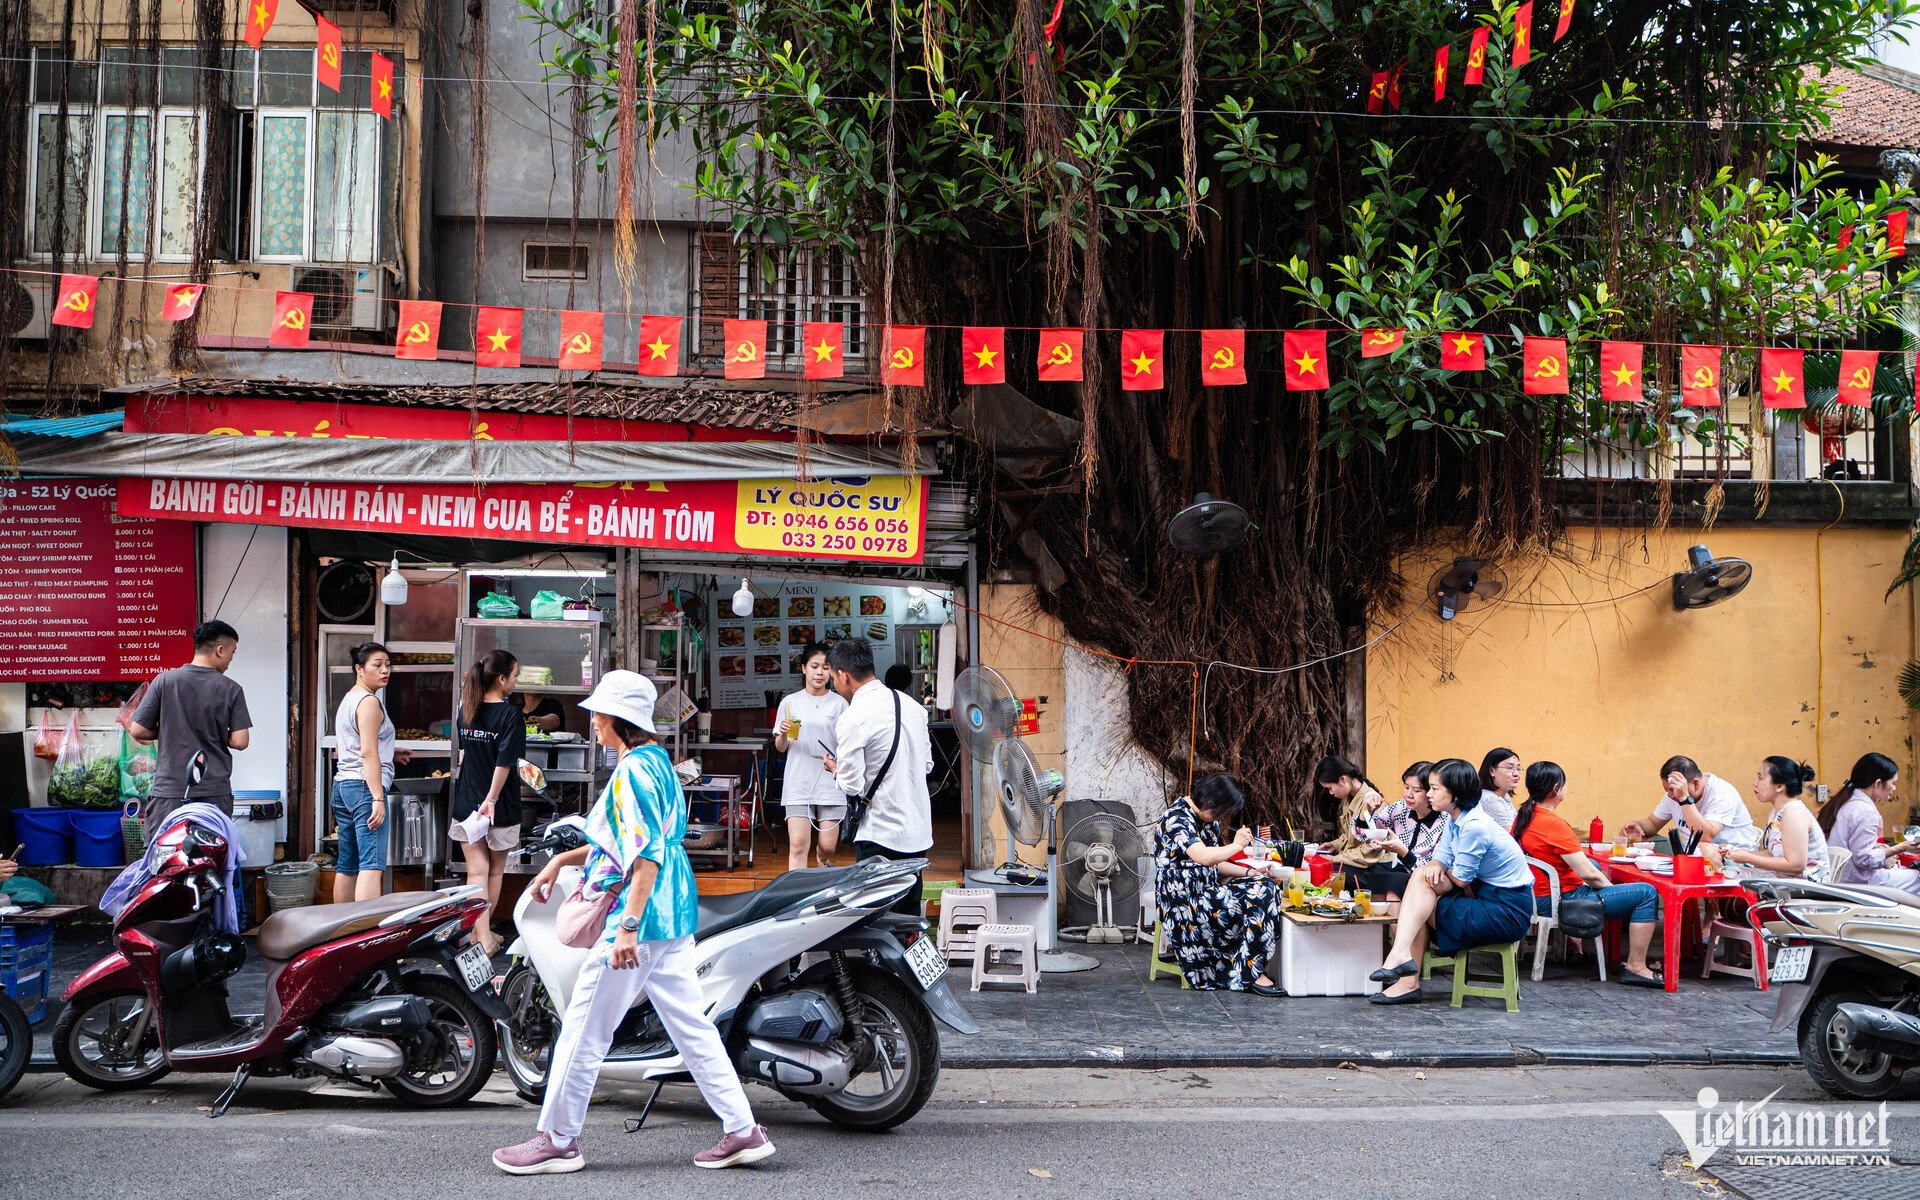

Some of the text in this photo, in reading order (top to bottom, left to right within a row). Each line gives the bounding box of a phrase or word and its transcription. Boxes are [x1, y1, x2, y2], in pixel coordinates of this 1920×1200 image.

[31, 486, 49, 497] 52
[54, 485, 71, 500] Lý
[75, 484, 116, 499] Quốc
[755, 487, 902, 511] LÝ QUỐC SƯ
[279, 481, 347, 521] BÁNH
[353, 485, 405, 524] RÁN
[420, 494, 476, 528] NEM
[483, 498, 532, 532] CUA
[539, 489, 574, 534] BỂ
[587, 499, 655, 539] BÁNH
[662, 503, 715, 543] TÔM
[746, 510, 909, 534] ĐT: 0946 656 056
[782, 532, 908, 553] 033 250 0978
[785, 586, 818, 595] MENU
[910, 939, 933, 968] 29-F1
[1780, 948, 1806, 963] 29-C1
[918, 954, 946, 985] 599.99
[1774, 964, 1805, 979] 929.79
